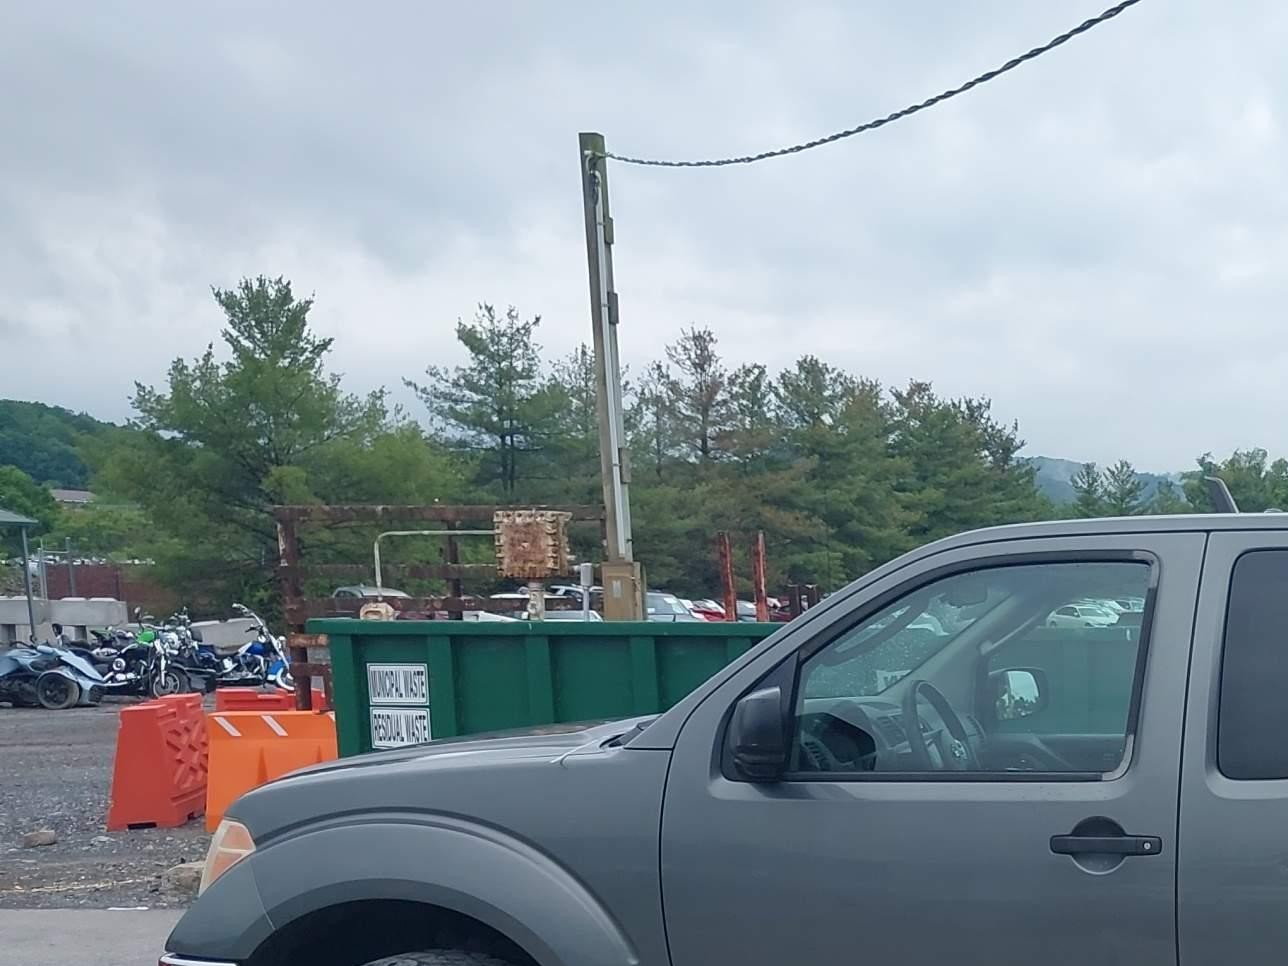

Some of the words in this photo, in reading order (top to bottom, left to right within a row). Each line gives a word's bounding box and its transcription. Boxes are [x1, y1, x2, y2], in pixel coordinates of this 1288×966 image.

[371, 669, 403, 698] MUNICIPAL
[403, 670, 426, 699] WASTE
[373, 713, 405, 742] RESIDUAL
[405, 714, 428, 743] WASTE
